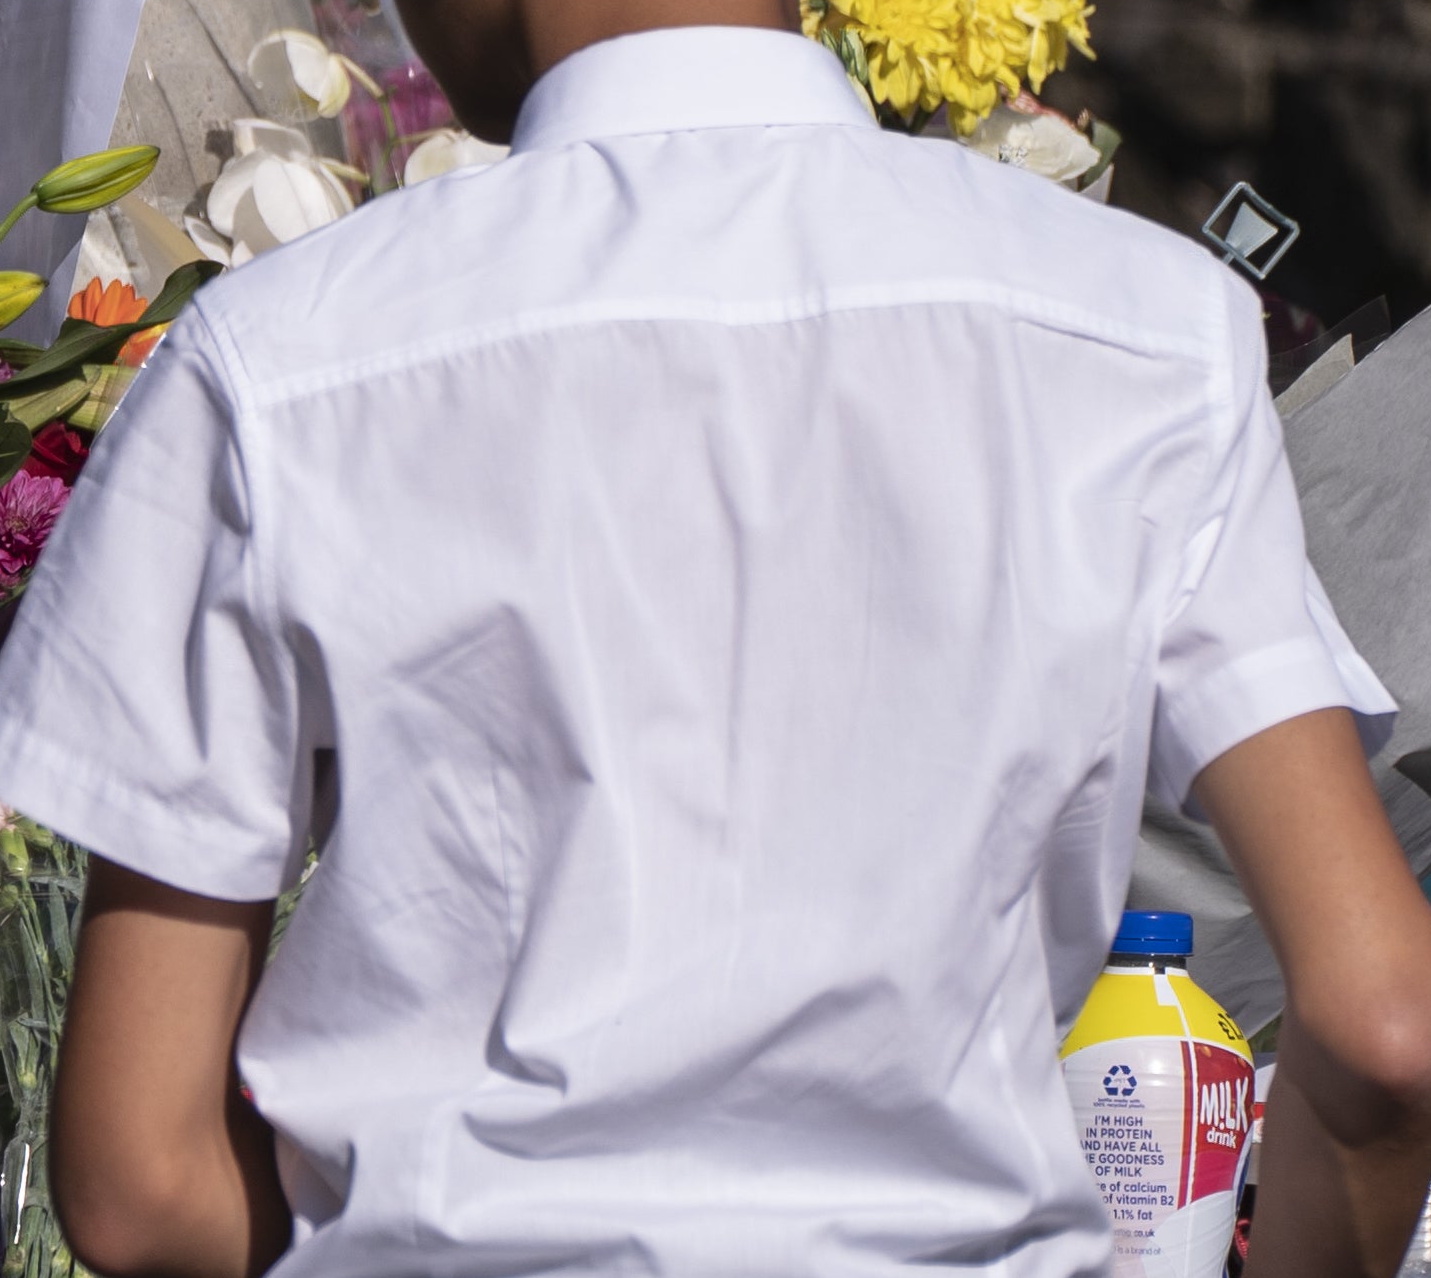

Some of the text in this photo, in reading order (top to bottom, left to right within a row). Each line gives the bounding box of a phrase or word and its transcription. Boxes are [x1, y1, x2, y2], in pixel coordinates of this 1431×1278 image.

[1094, 1115, 1143, 1127] I'M HIGH
[1086, 1128, 1152, 1140] IN PROTEIN
[1206, 1127, 1237, 1149] drink
[1104, 1141, 1136, 1152] HAVE
[1140, 1142, 1162, 1153] ALL
[1098, 1153, 1165, 1166] GOODNESS
[1095, 1165, 1142, 1178] OF MILK
[1110, 1181, 1121, 1192] of
[1124, 1182, 1167, 1193] calcium
[1116, 1195, 1157, 1205] vitamin
[1160, 1195, 1175, 1206] B2
[1137, 1209, 1153, 1221] fat
